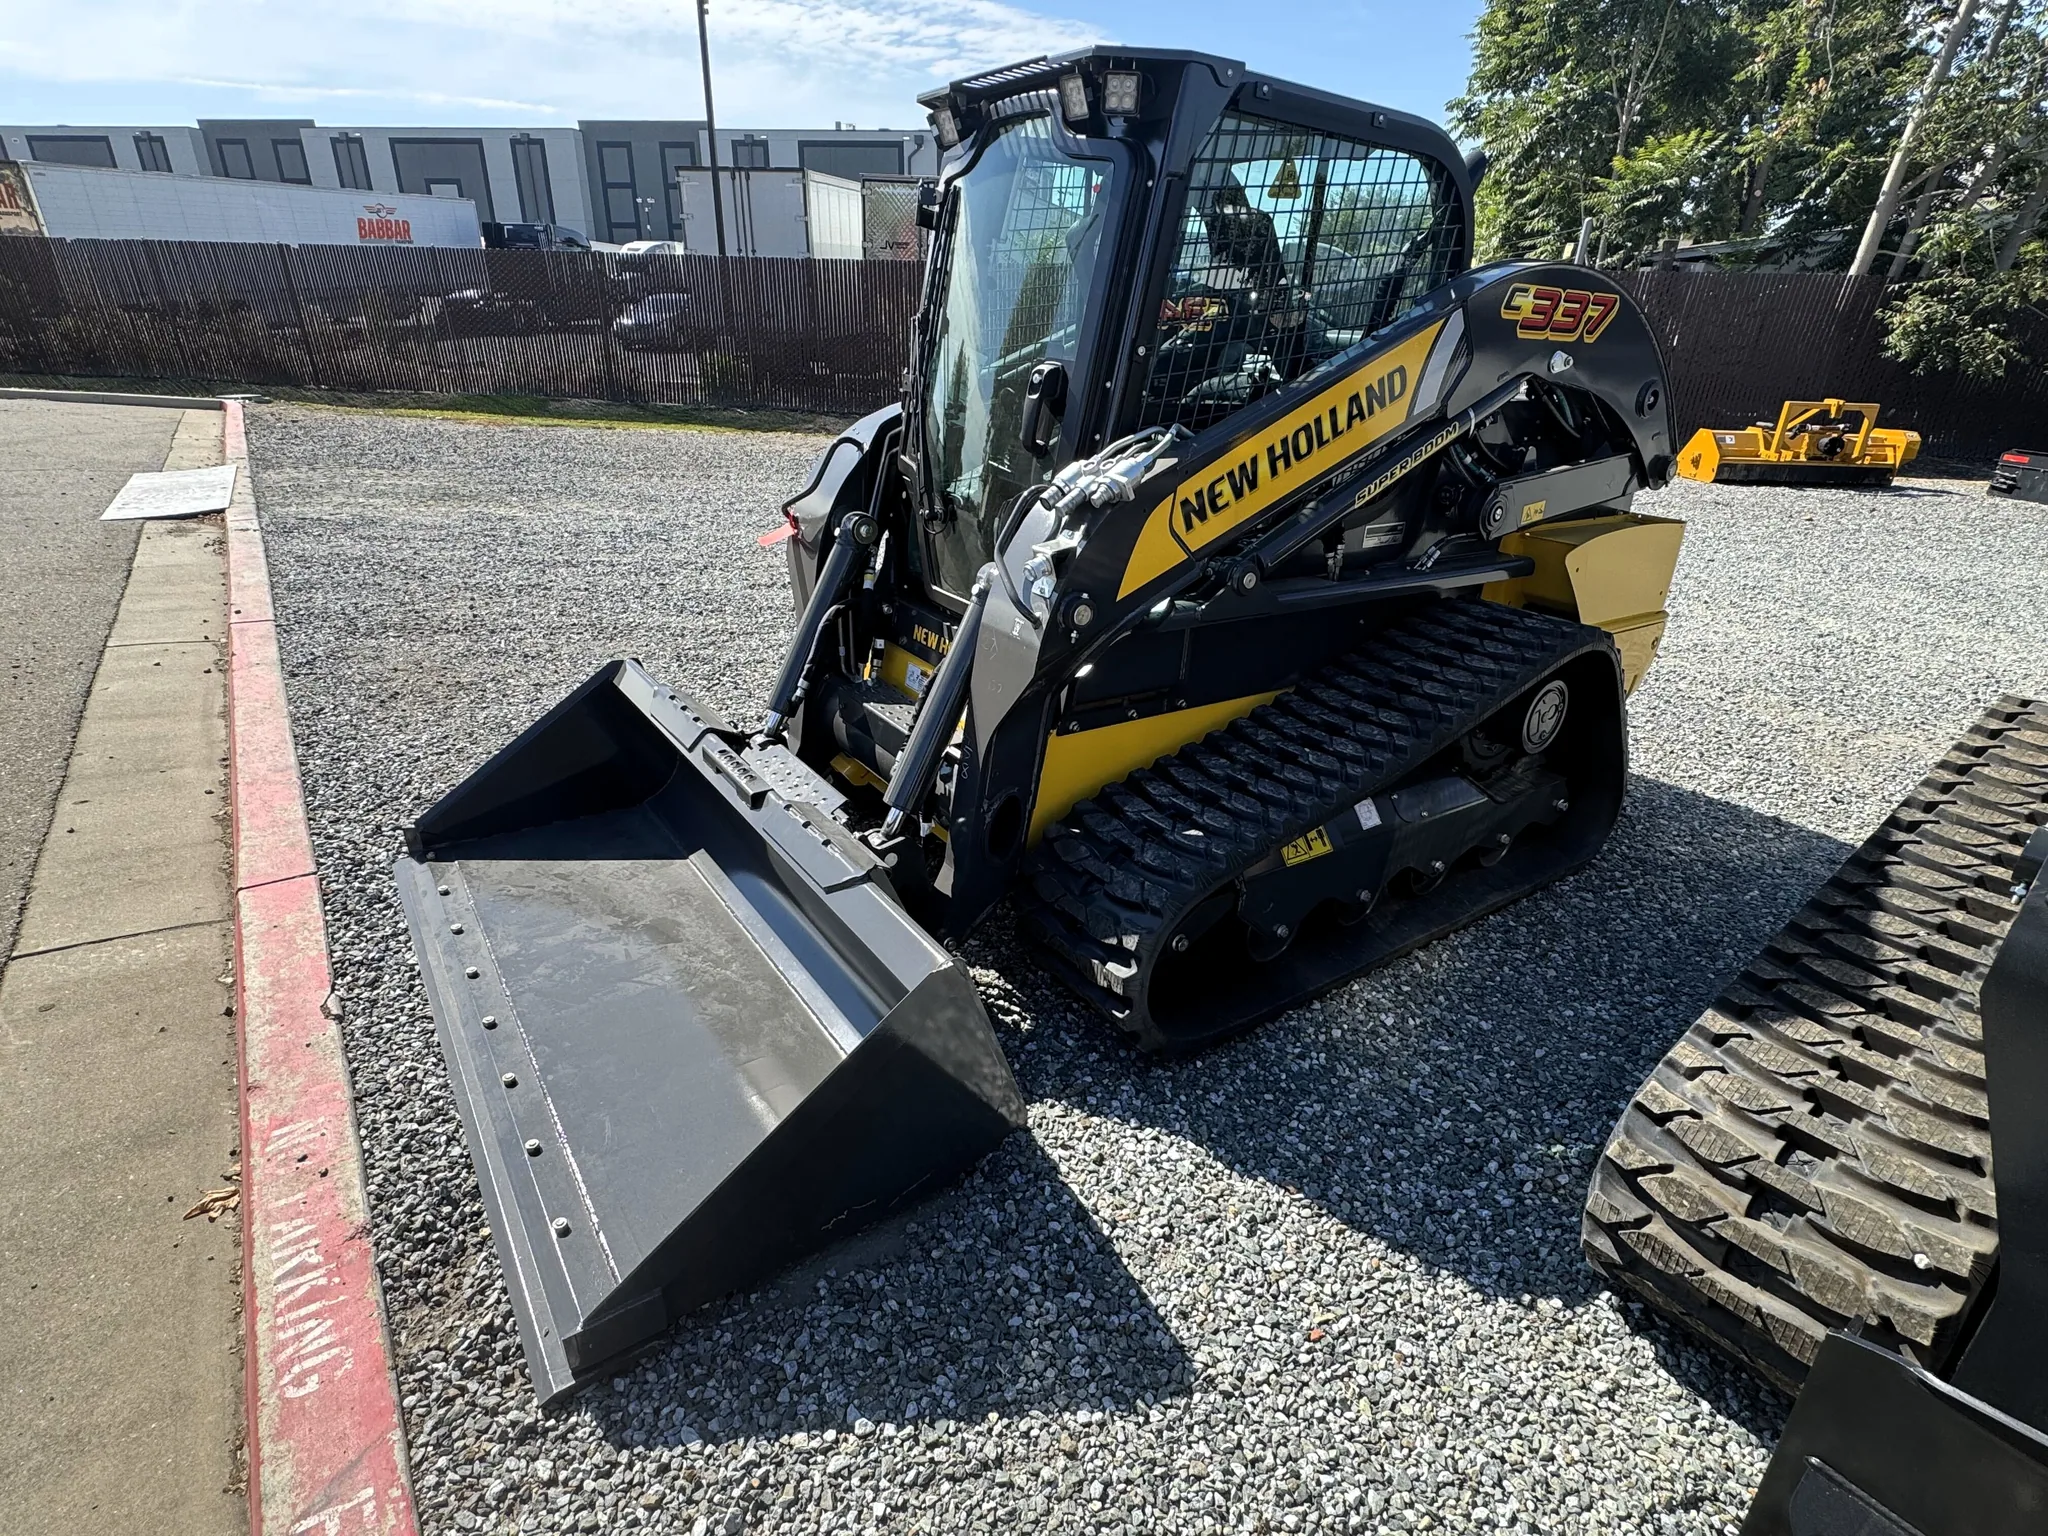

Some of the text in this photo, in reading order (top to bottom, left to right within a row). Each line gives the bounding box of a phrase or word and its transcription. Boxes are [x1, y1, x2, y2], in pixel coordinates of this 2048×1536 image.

[357, 217, 411, 240] BABBAR
[1501, 283, 1620, 343] C337
[1179, 453, 1259, 535] NEW
[1266, 364, 1408, 483] HOLLAND
[1354, 457, 1412, 508] SUPER
[1412, 421, 1460, 464] BOOM
[912, 623, 939, 650] NEW
